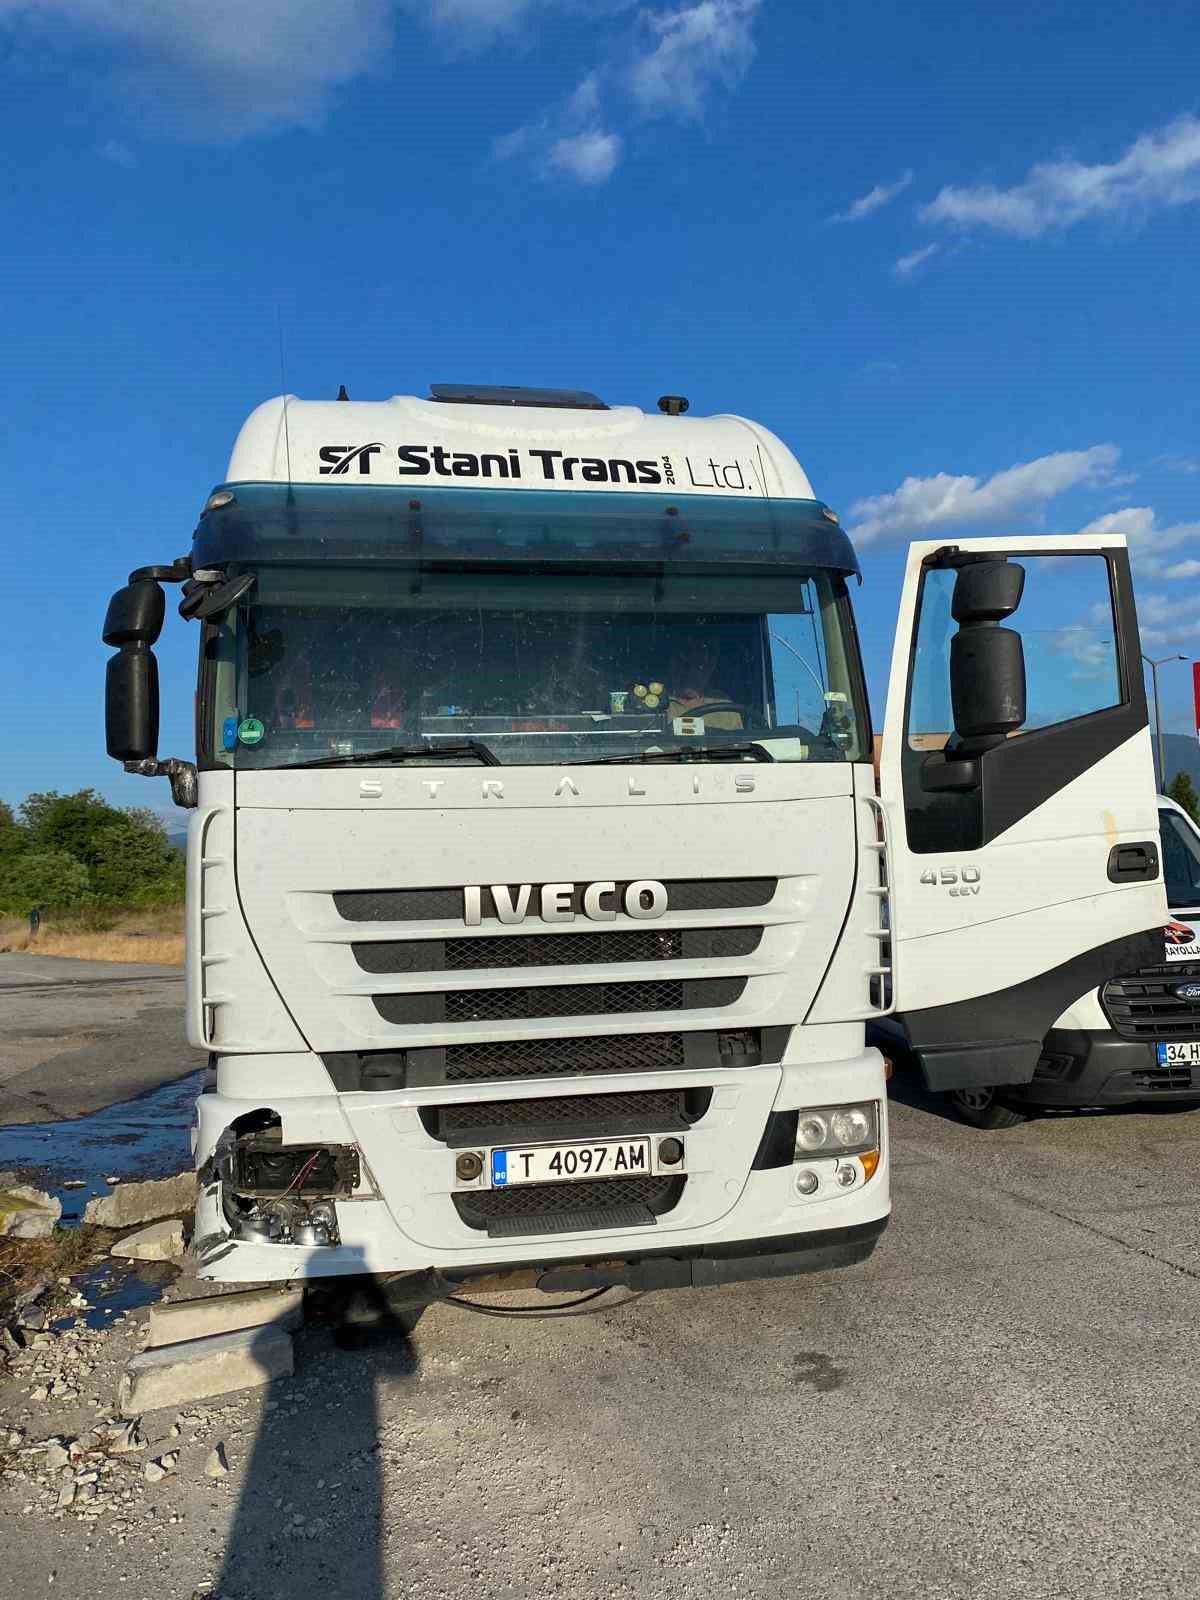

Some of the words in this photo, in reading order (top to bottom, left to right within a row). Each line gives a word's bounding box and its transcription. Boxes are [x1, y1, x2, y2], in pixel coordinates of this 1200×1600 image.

[398, 445, 521, 479] Stani
[529, 449, 662, 484] Trans
[686, 456, 753, 490] Ltd.
[665, 455, 676, 485] 2004
[359, 775, 756, 799] STRALIS
[919, 866, 981, 886] 450
[463, 880, 668, 927] IVECO
[948, 886, 981, 897] EEV
[1168, 1045, 1185, 1060] 34
[1190, 1044, 1200, 1059] H
[519, 1153, 535, 1178] T
[548, 1147, 608, 1175] 4097
[614, 1145, 645, 1170] AM
